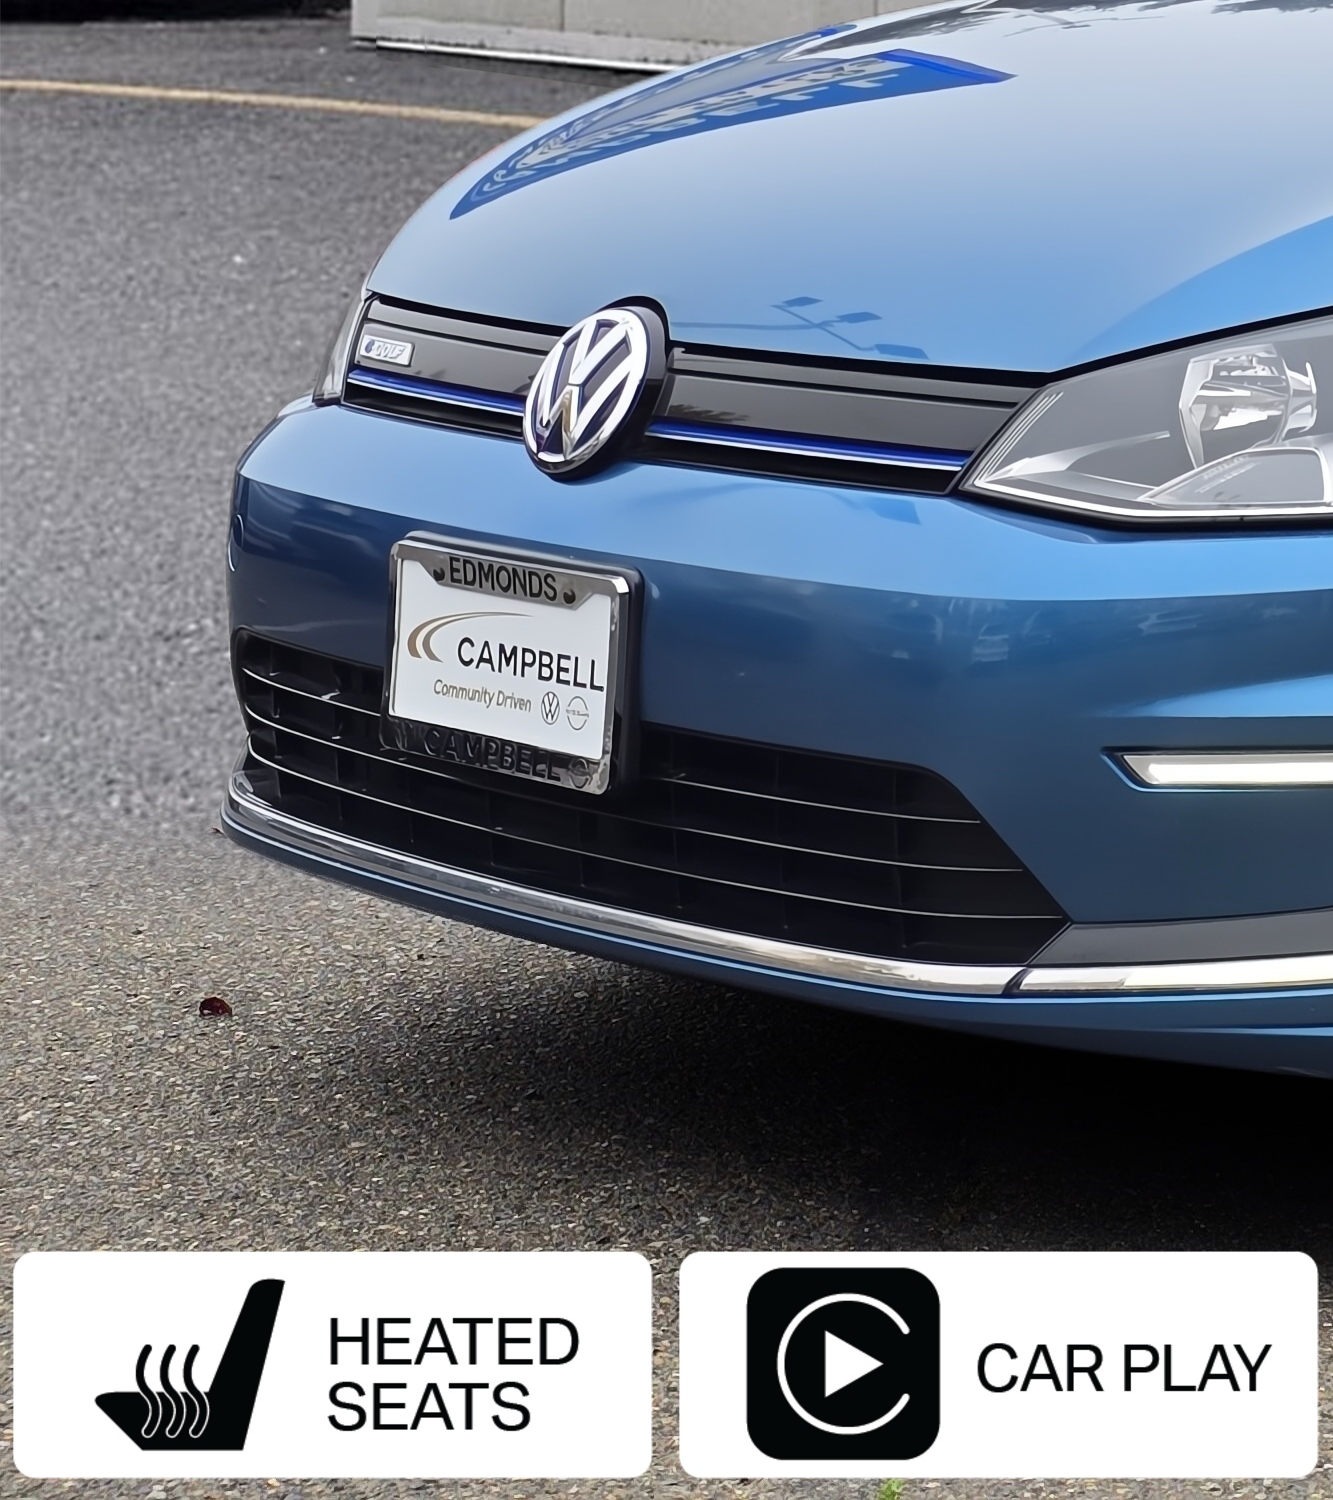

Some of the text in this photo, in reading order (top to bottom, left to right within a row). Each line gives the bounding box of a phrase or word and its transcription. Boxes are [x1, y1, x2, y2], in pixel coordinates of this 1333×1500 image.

[449, 556, 558, 602] EDMONDS
[457, 636, 604, 692] CAMPBELL
[433, 678, 532, 713] Community Driven
[424, 725, 561, 782] CAMPBELL
